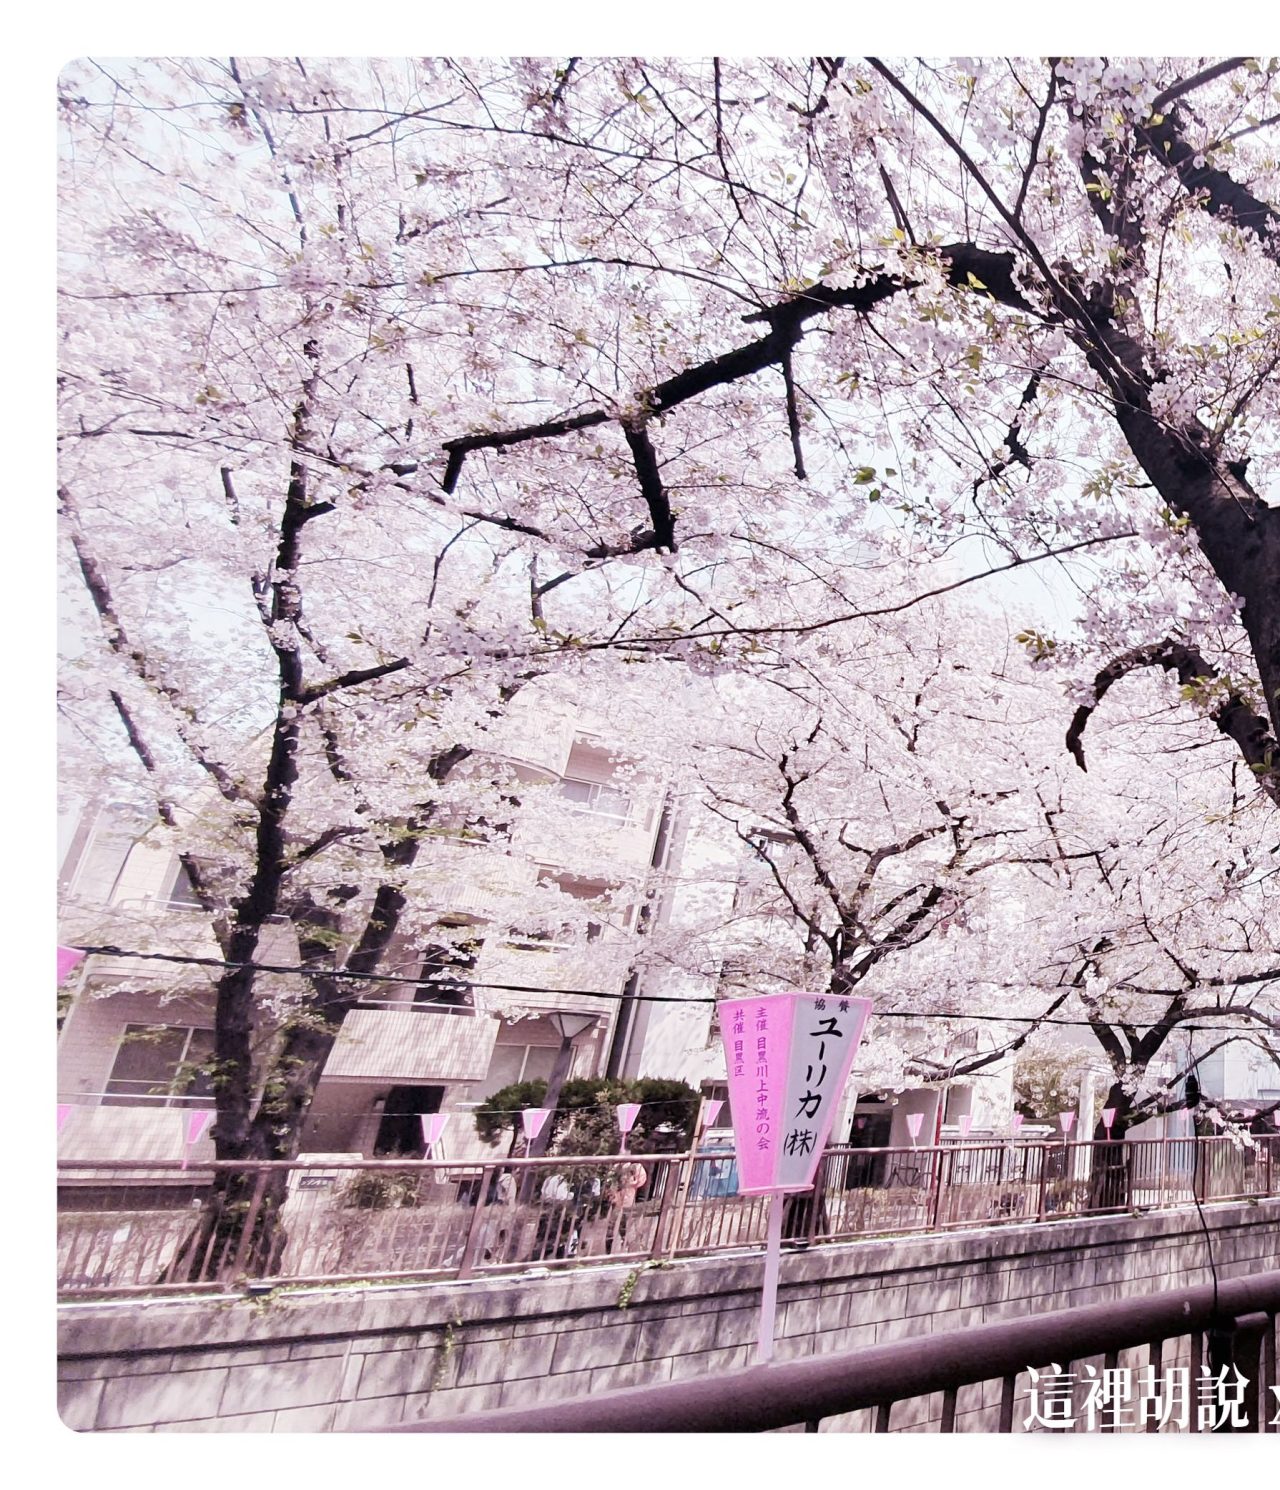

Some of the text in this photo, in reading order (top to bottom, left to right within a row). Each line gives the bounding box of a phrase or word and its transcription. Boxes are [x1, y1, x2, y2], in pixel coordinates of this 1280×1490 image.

[733, 1009, 745, 1077] 共催 目黒区
[755, 1007, 771, 1150] 主催 目黒川上中流の会
